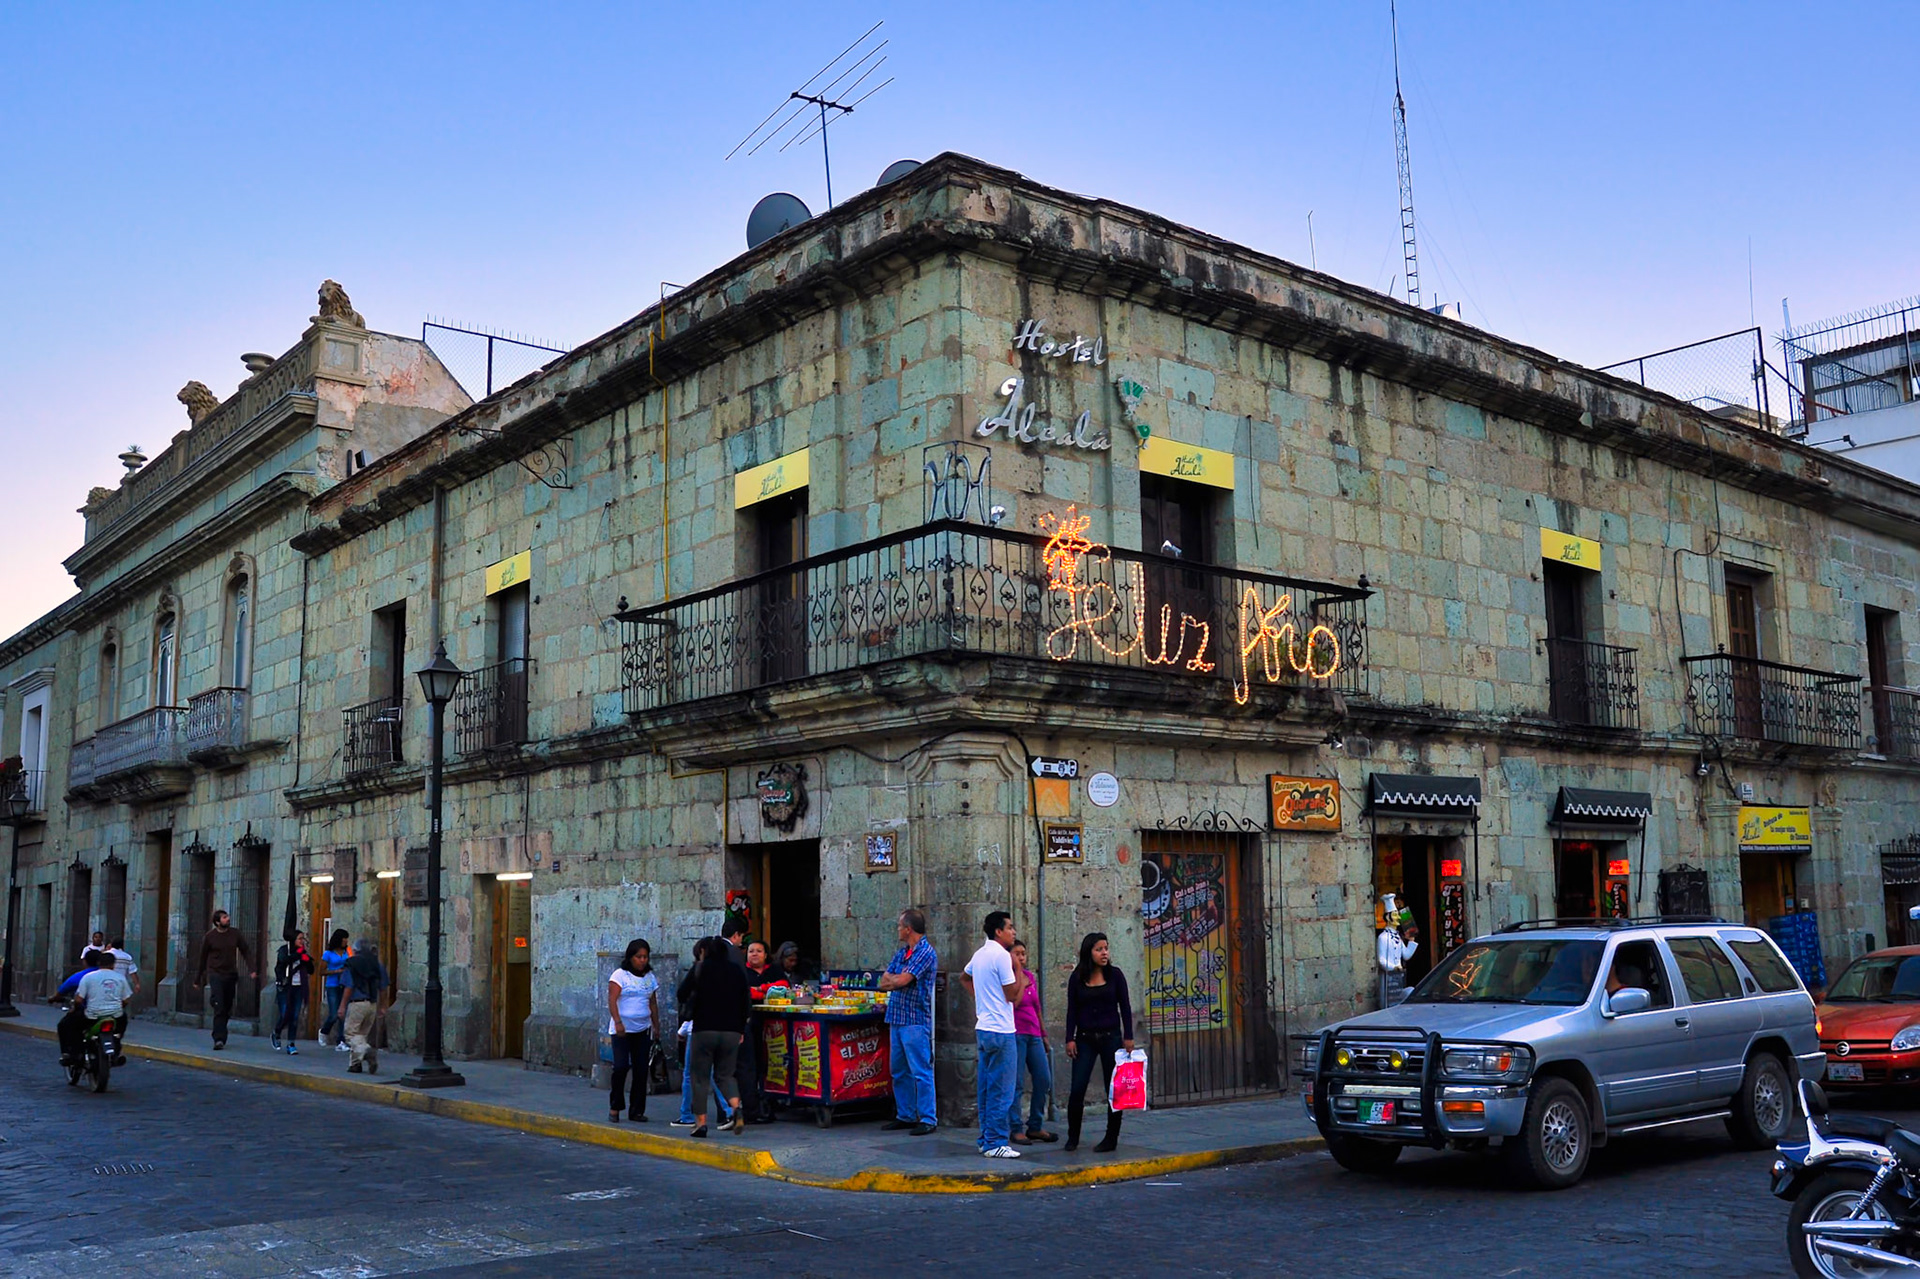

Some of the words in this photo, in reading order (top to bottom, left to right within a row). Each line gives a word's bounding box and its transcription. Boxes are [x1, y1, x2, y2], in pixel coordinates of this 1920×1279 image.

[1013, 319, 1107, 365] Hostel
[840, 1045, 855, 1059] EL
[857, 1038, 879, 1054] REY
